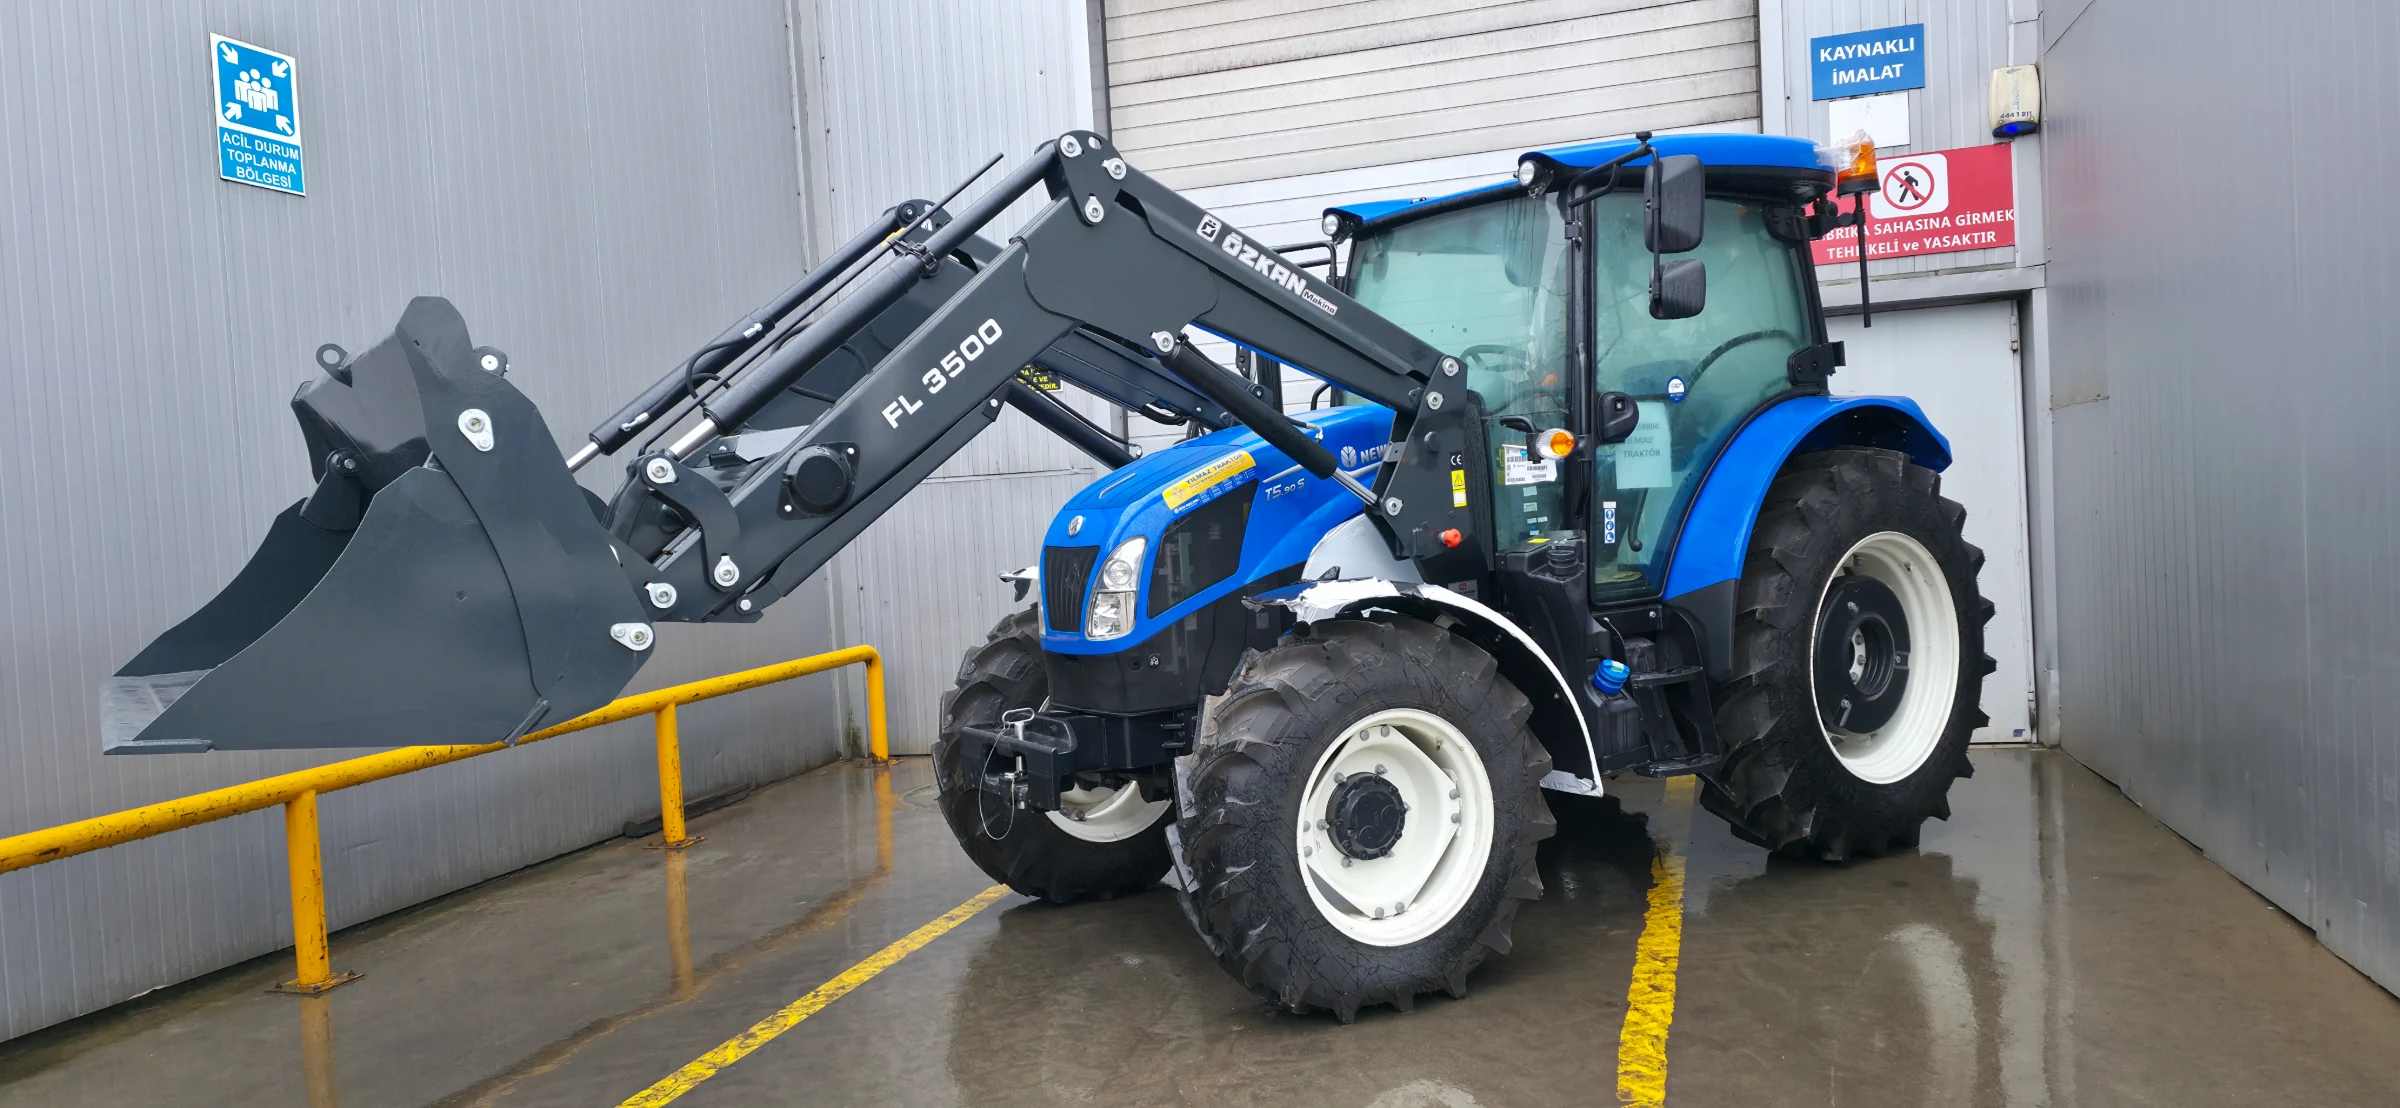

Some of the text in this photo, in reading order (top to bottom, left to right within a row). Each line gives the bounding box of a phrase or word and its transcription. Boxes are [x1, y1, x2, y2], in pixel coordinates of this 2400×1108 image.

[1819, 37, 1915, 63] KAYNAKLI
[1832, 63, 1904, 86] İMALAT
[222, 131, 299, 161] ACİL DURUM
[226, 148, 297, 175] TOPLANMA
[236, 166, 291, 188] BÖLGESİ
[1820, 209, 2015, 242] BRIKA SAHASINA GİRMEK
[1902, 239, 1920, 252] ve
[1923, 231, 1997, 248] YASAKTIR
[1221, 231, 1307, 296] ÖZKAN
[881, 318, 1003, 430] FL 3500
[1624, 436, 1653, 445] ILMAZ
[1360, 443, 1388, 464] NEW
[1622, 447, 1661, 458] TRAKTÖR
[1297, 477, 1305, 489] S
